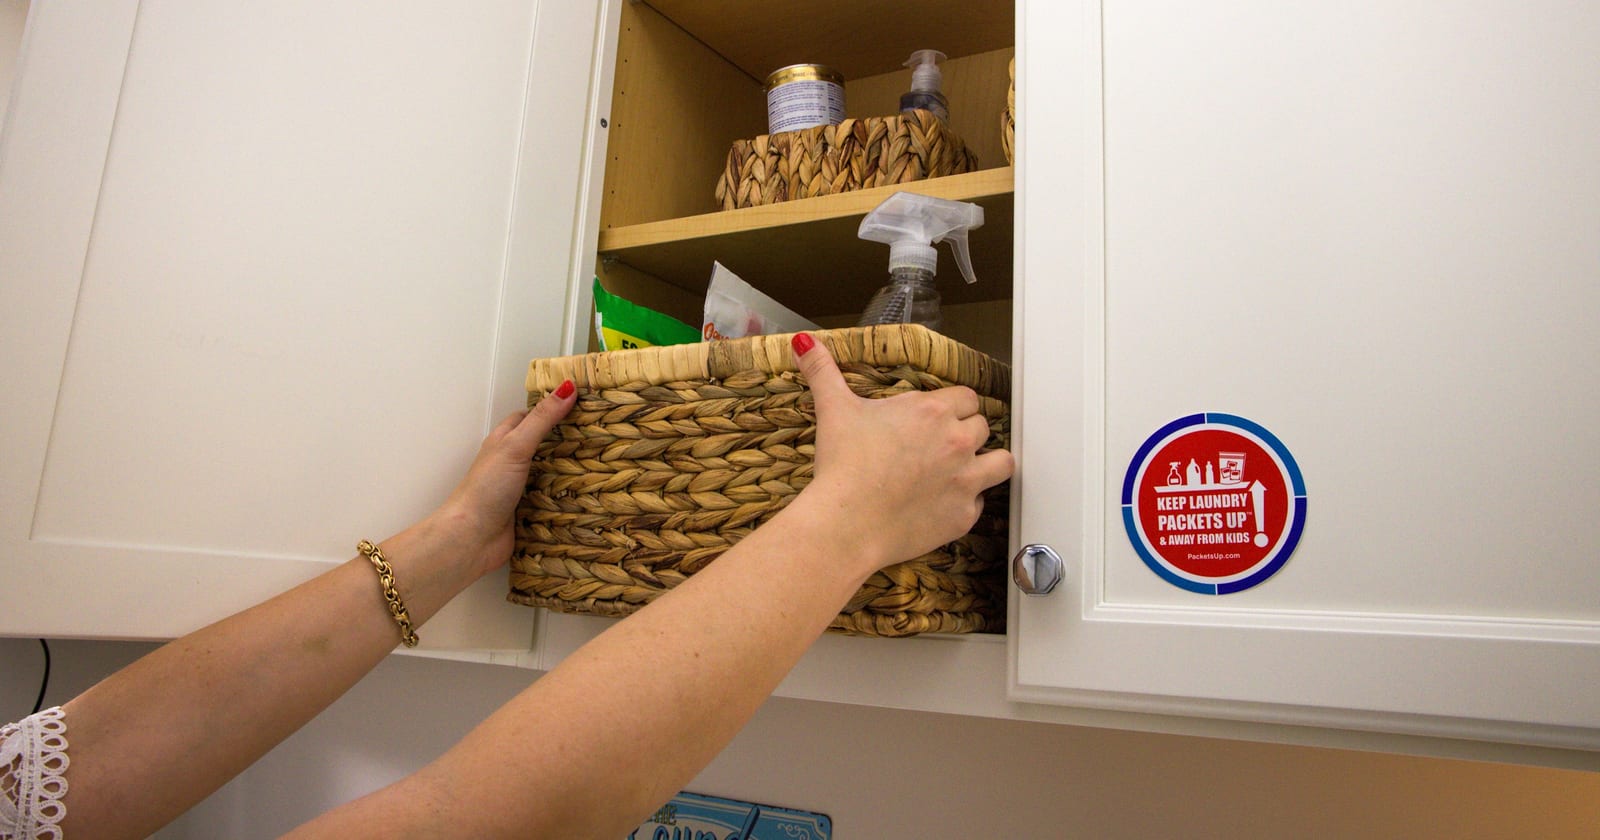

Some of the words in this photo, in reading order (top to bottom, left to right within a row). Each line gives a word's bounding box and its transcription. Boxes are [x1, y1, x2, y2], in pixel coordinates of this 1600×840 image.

[1157, 496, 1186, 511] KEEP
[1189, 493, 1248, 510] LAUNDRY
[1158, 513, 1223, 531] PACKETS
[1159, 536, 1167, 546] &
[1168, 534, 1195, 545] AWAY
[1197, 533, 1224, 545] FROM
[1226, 532, 1250, 544] KIDS
